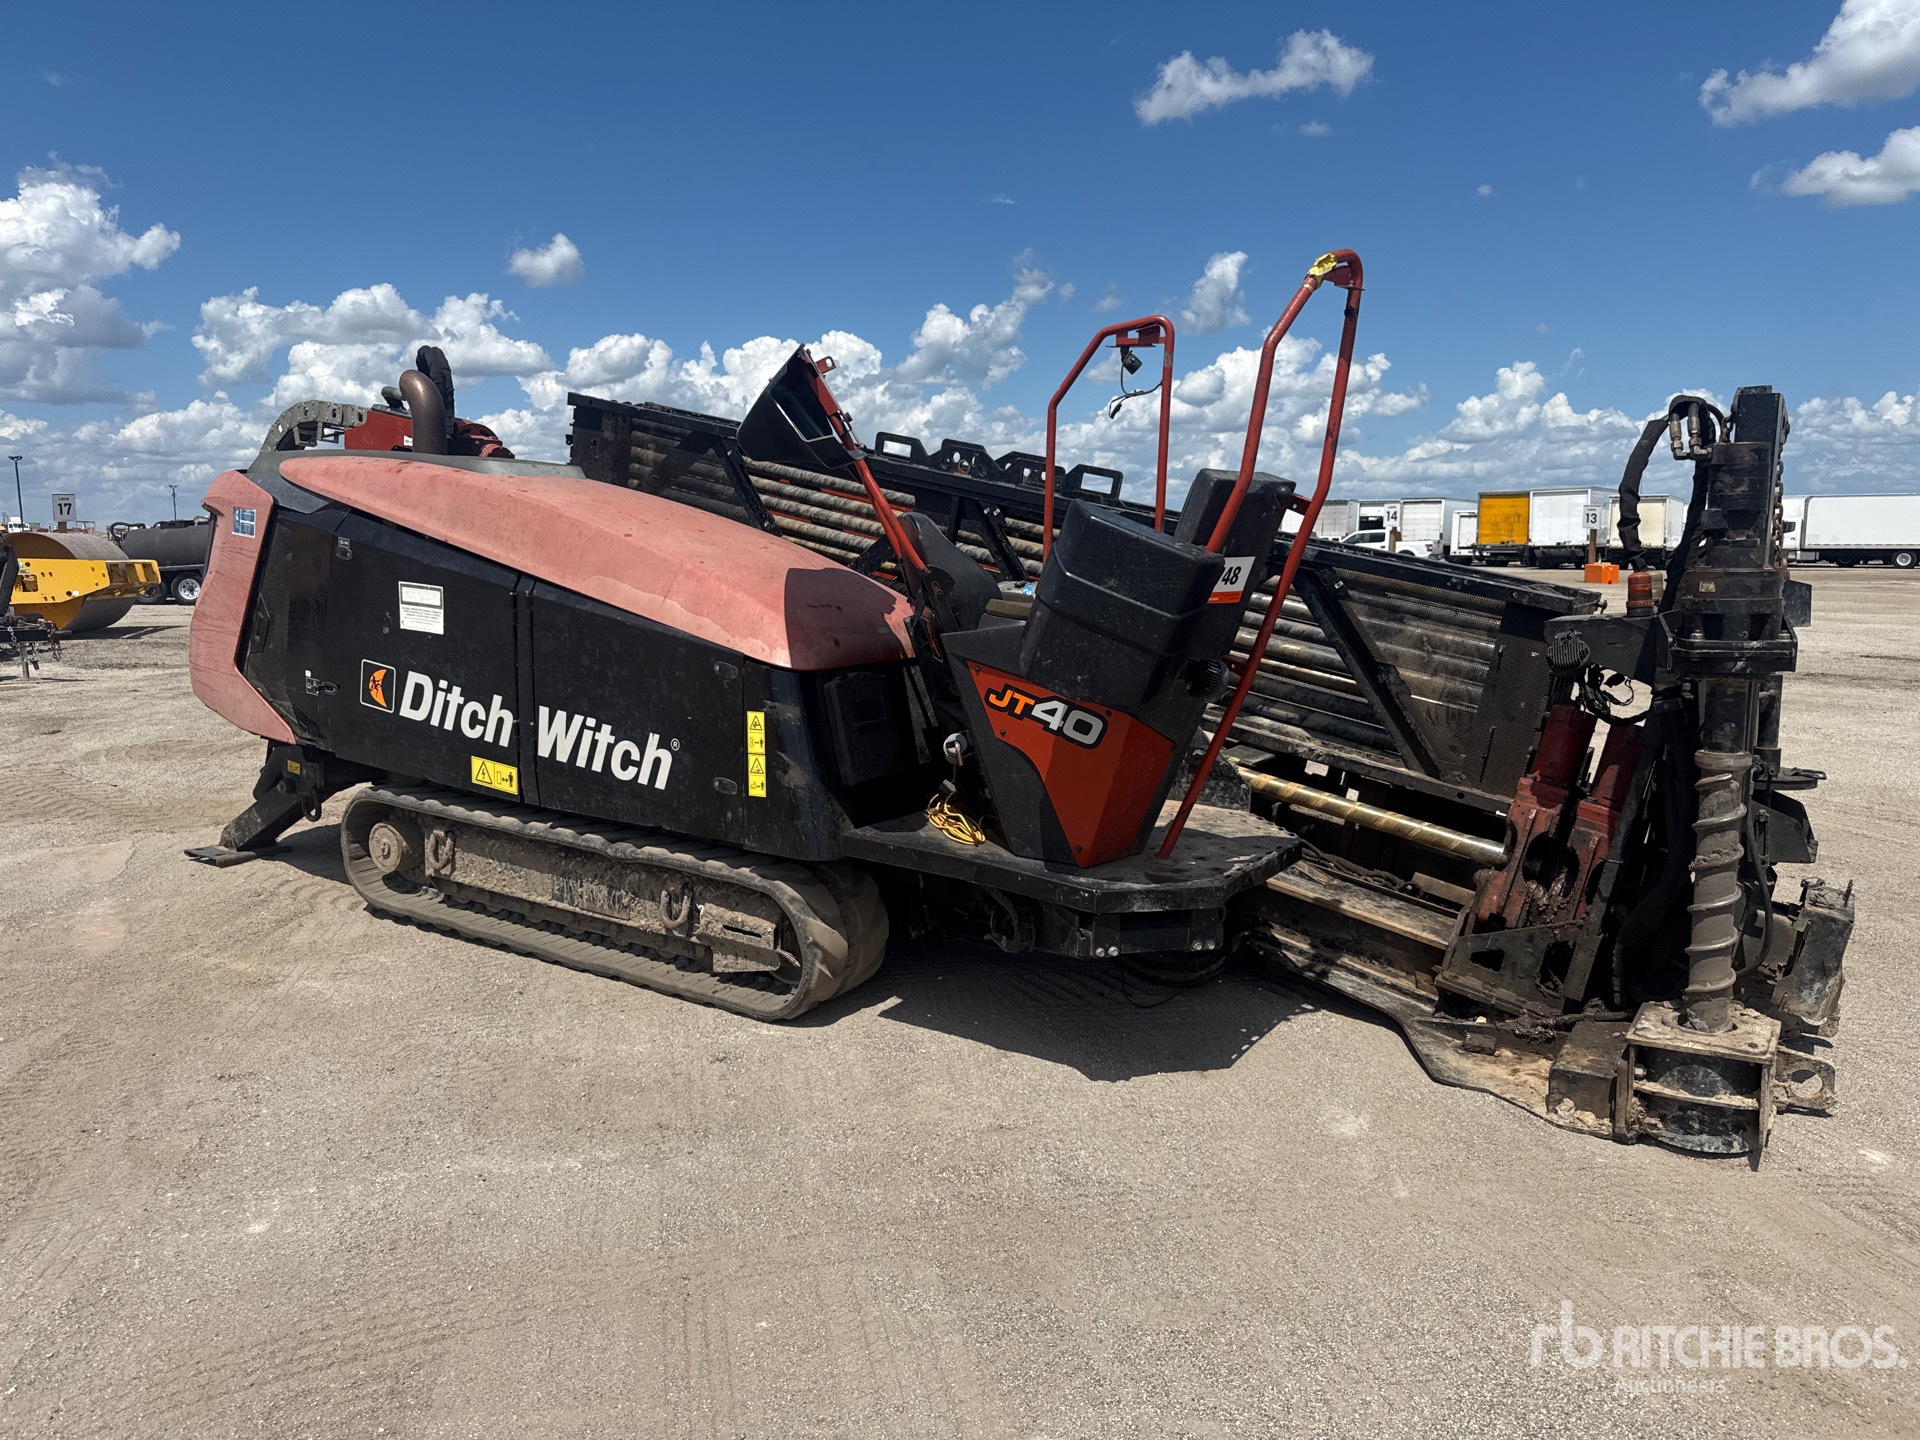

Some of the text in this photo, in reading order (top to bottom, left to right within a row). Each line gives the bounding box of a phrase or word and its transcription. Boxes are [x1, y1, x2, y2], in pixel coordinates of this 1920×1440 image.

[57, 503, 72, 516] 17
[1386, 510, 1398, 522] 14
[1585, 513, 1597, 524] 13
[1221, 565, 1242, 586] 48
[399, 671, 514, 747] Ditch
[987, 688, 1105, 746] JT40
